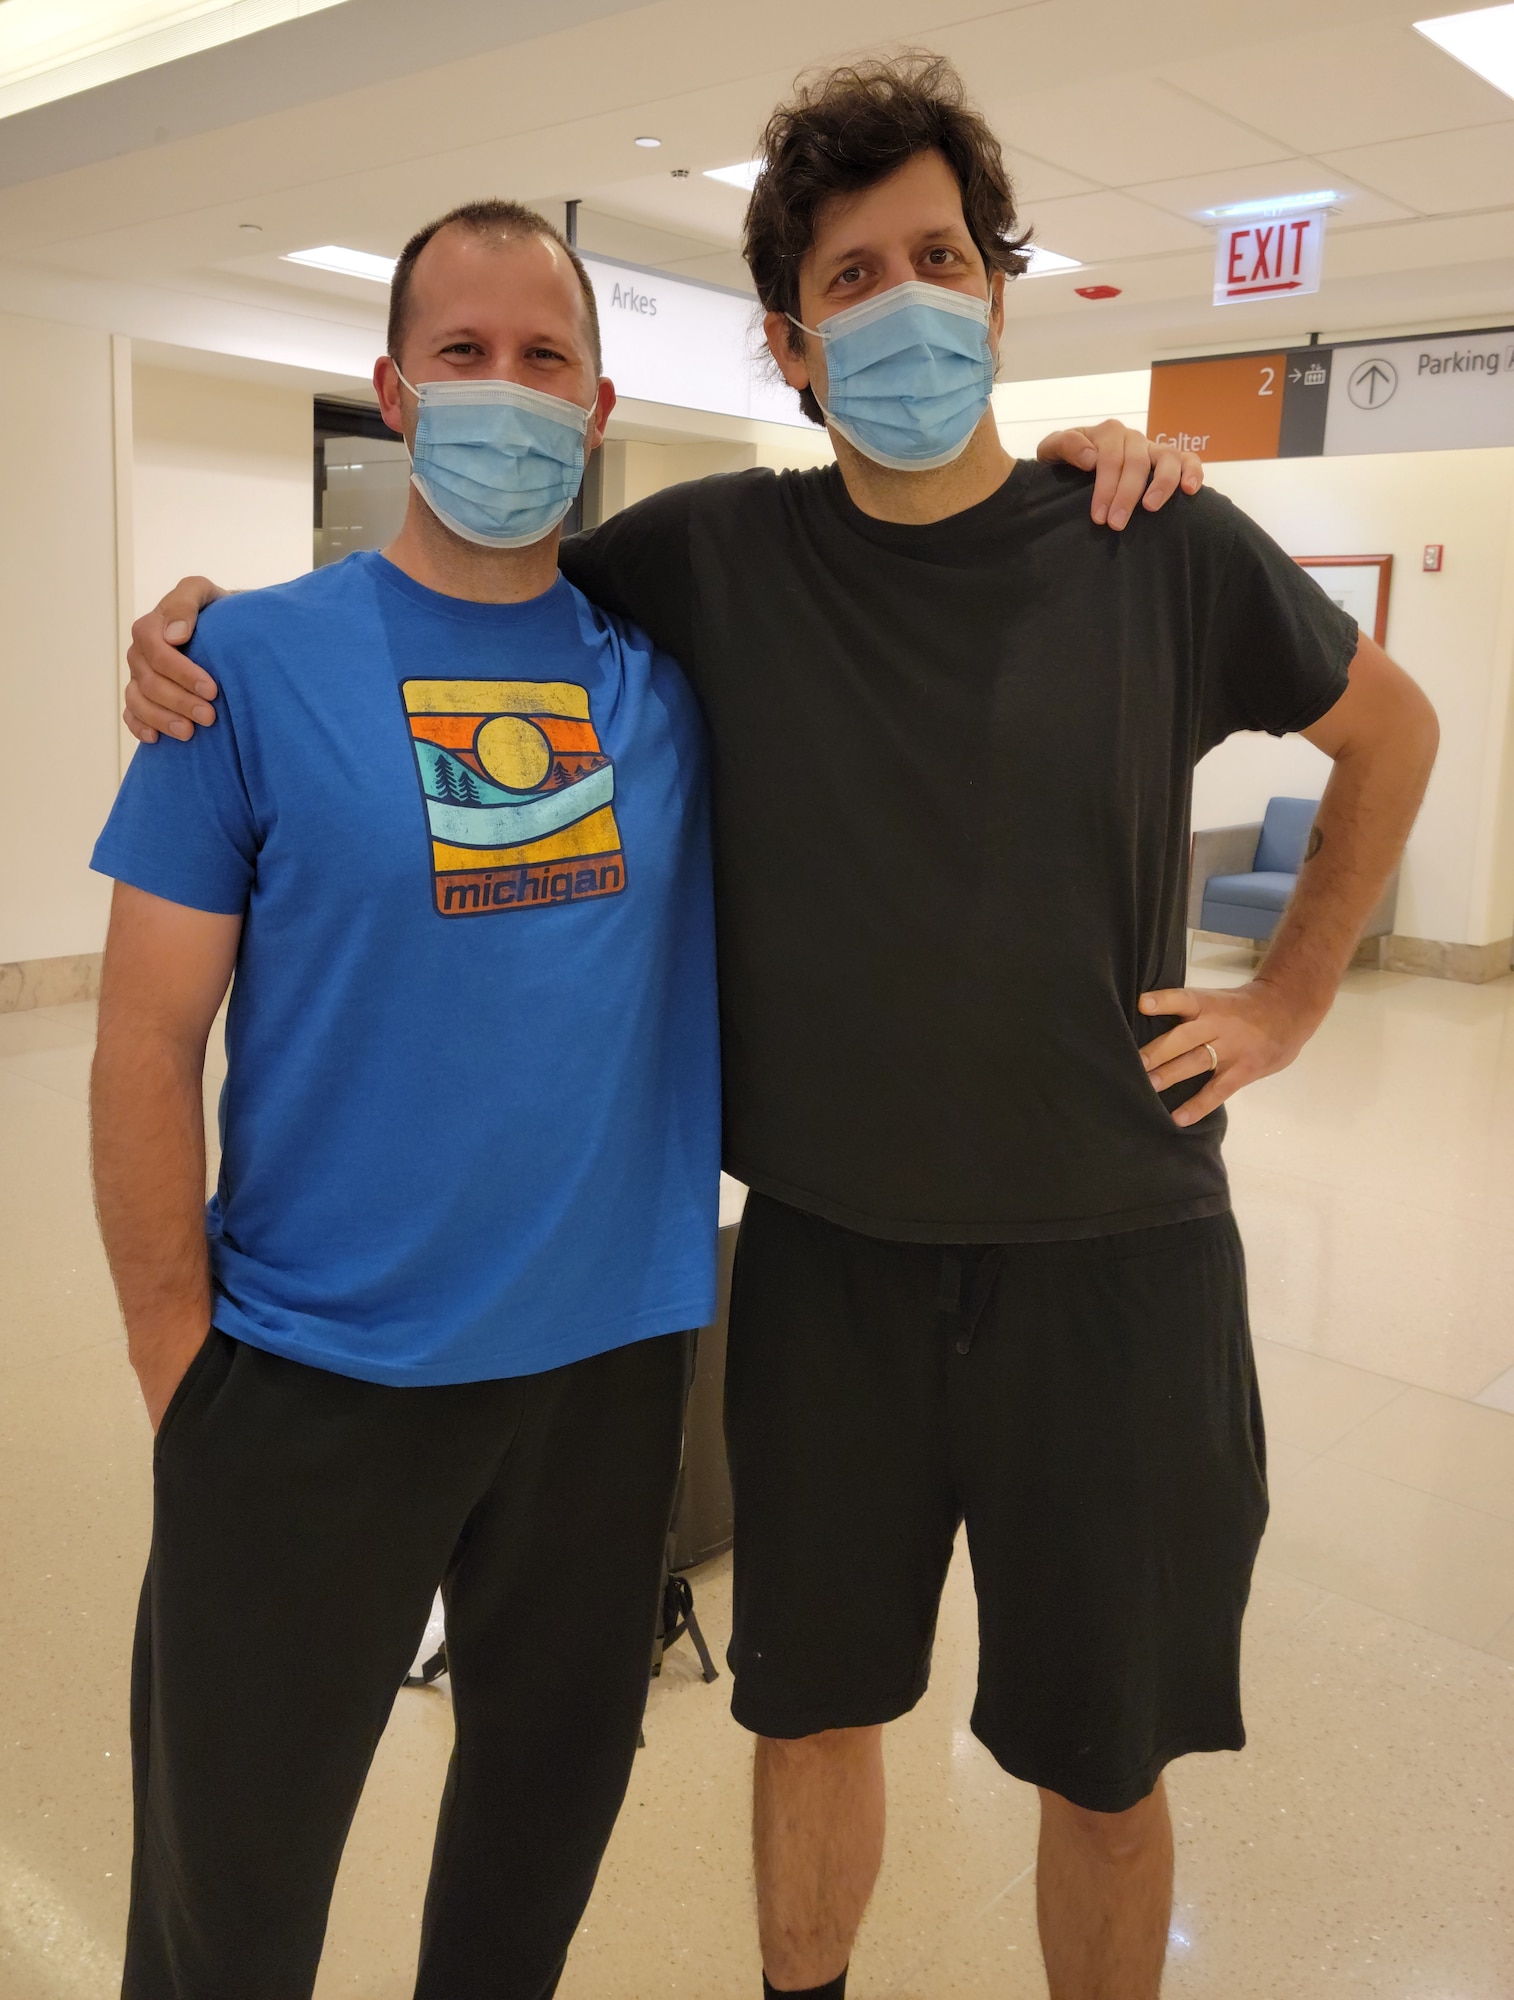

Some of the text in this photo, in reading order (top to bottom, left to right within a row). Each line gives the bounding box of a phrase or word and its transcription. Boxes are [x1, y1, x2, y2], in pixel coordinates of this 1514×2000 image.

[1227, 220, 1311, 284] EXIT
[611, 282, 657, 316] Arkes
[1417, 349, 1500, 376] Parking
[1257, 367, 1275, 396] 2
[443, 864, 620, 910] michigan
